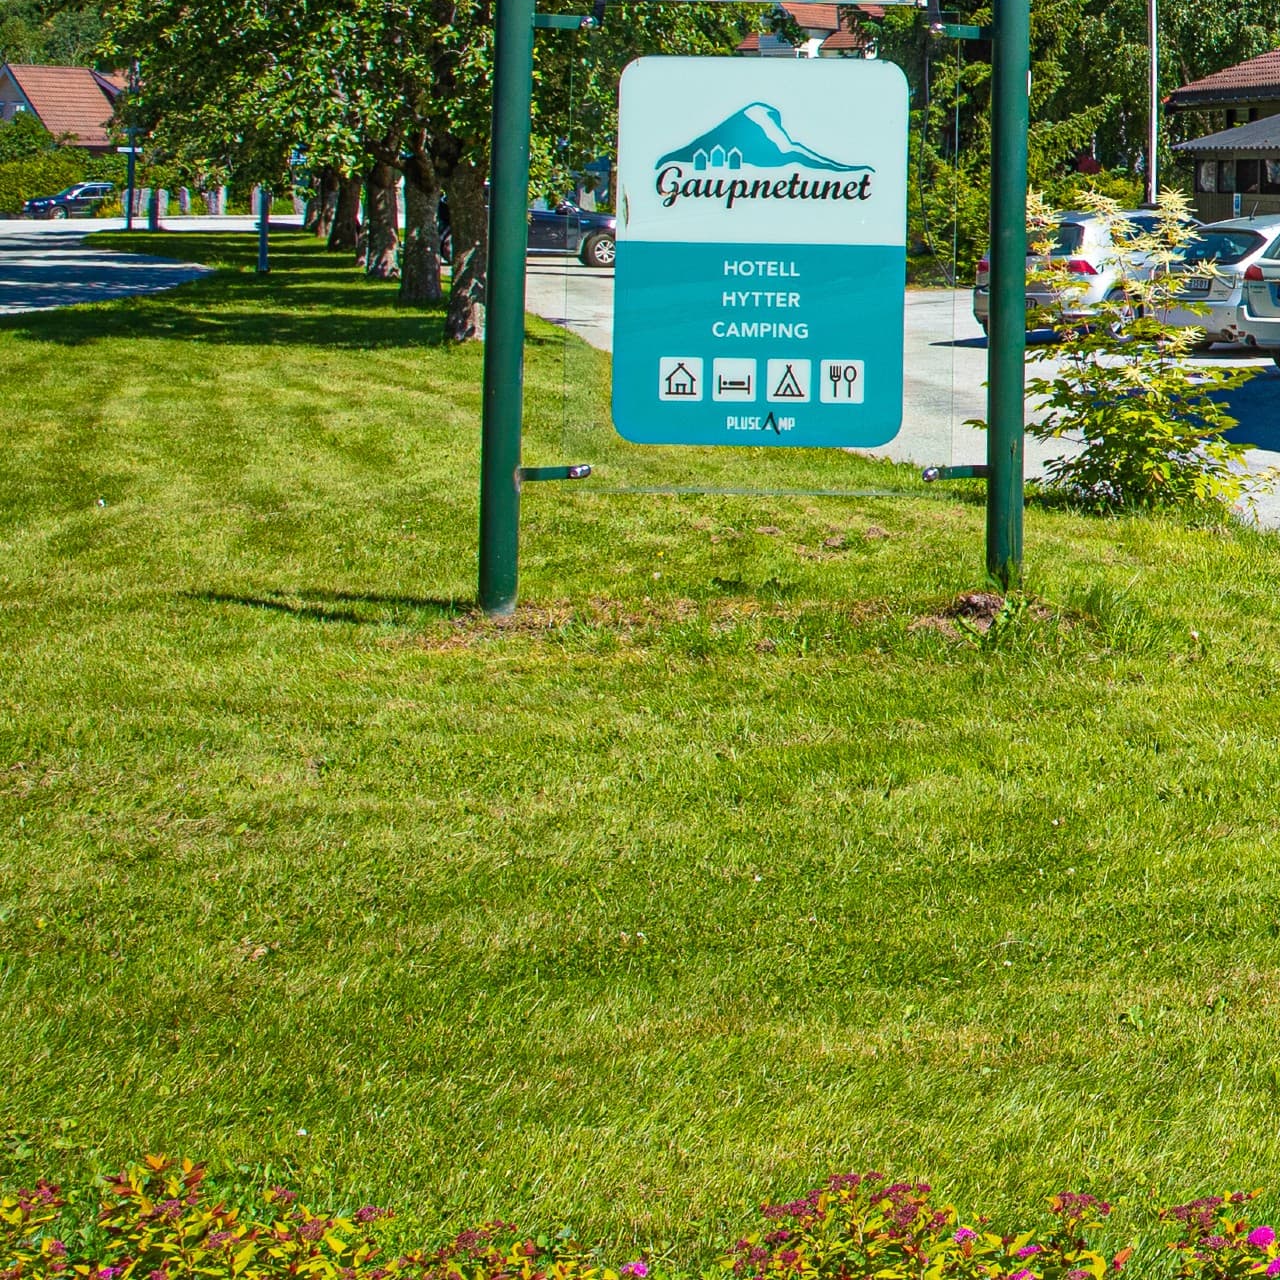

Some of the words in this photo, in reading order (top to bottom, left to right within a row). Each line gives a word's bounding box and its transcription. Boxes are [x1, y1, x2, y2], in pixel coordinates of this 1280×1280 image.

[656, 166, 872, 209] Gaupnetunet
[723, 260, 801, 277] HOTELL
[722, 291, 801, 308] HYTTER
[711, 321, 809, 339] CAMPING
[726, 411, 796, 435] PLUSCAMP
